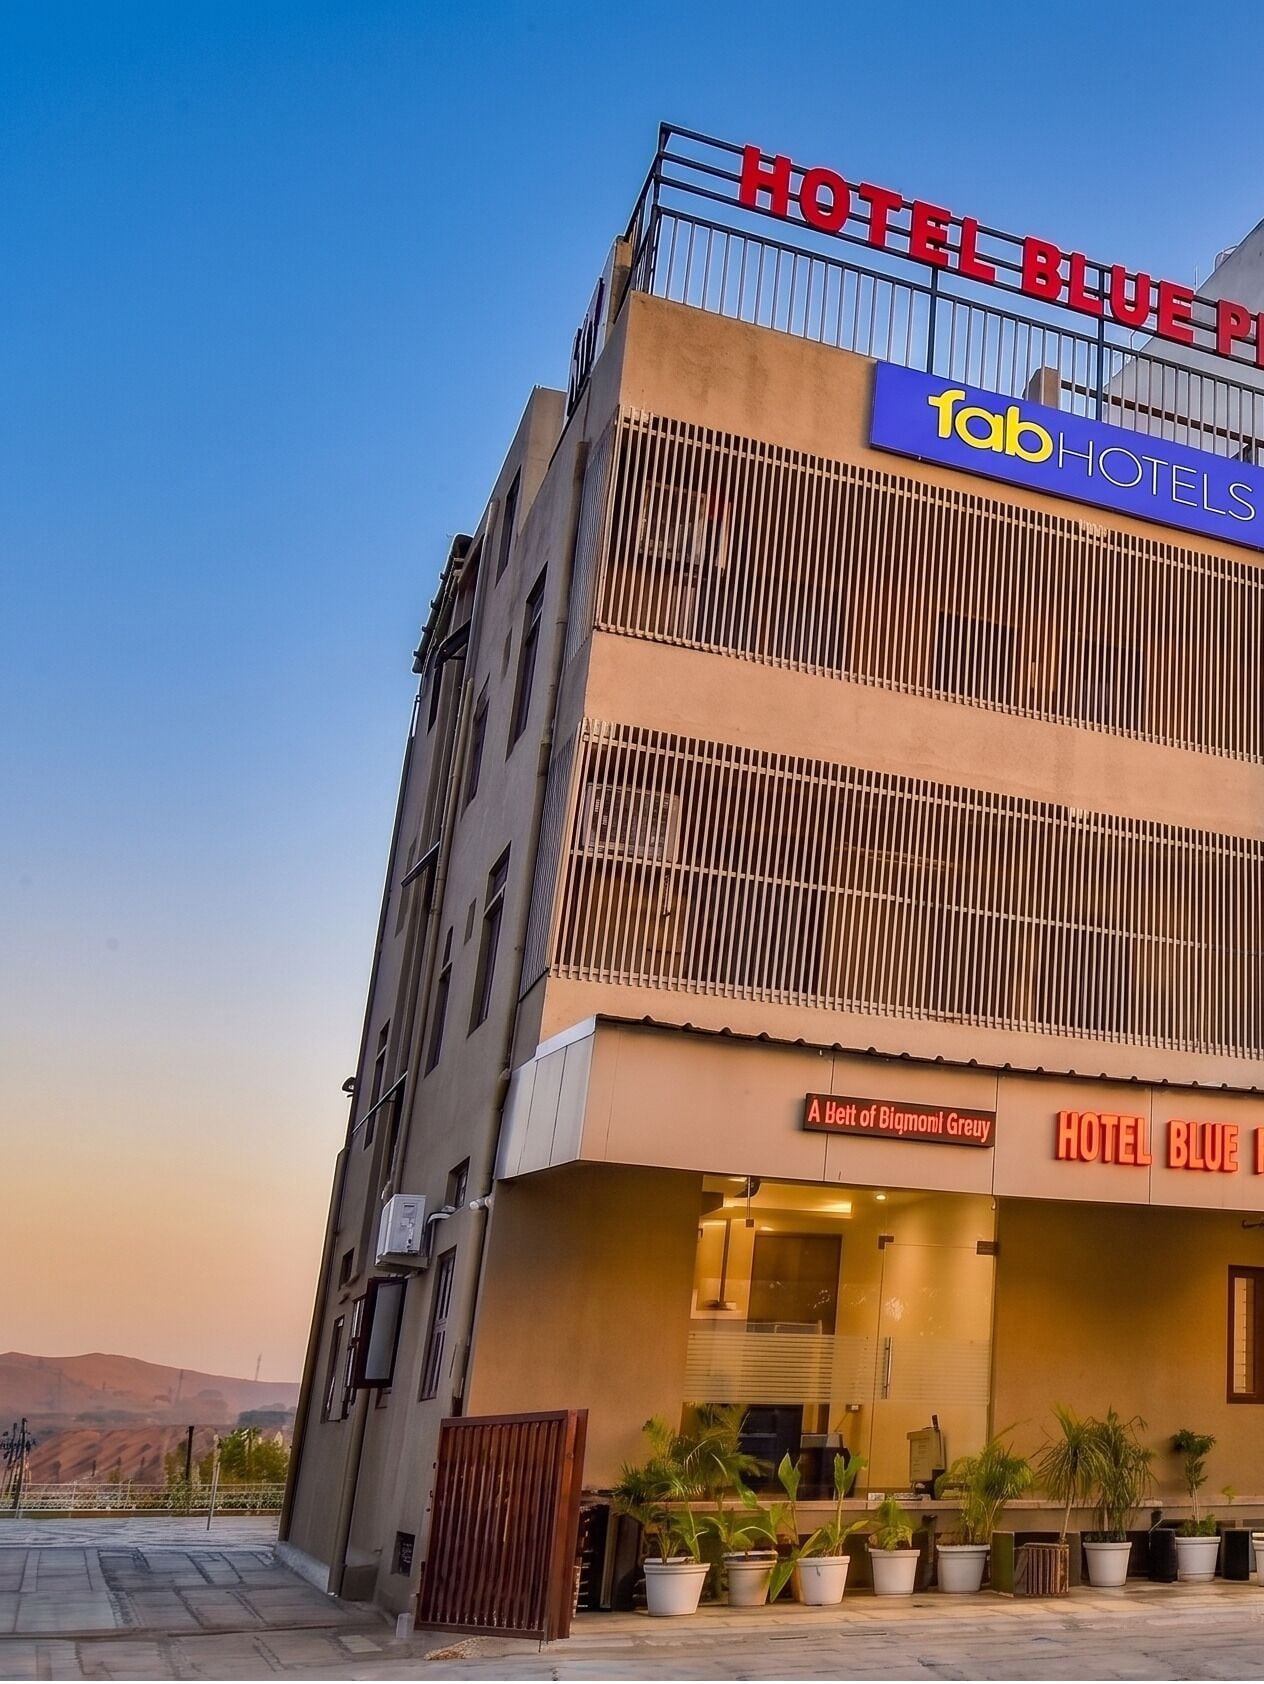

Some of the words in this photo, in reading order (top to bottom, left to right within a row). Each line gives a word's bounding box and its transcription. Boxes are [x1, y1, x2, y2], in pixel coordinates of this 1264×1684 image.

[739, 145, 995, 284] HOTEL
[1021, 235, 1194, 345] BLUE
[808, 1098, 820, 1123] A
[859, 1105, 876, 1127] of
[1056, 1111, 1151, 1166] HOTEL
[1166, 1120, 1239, 1173] BLUE
